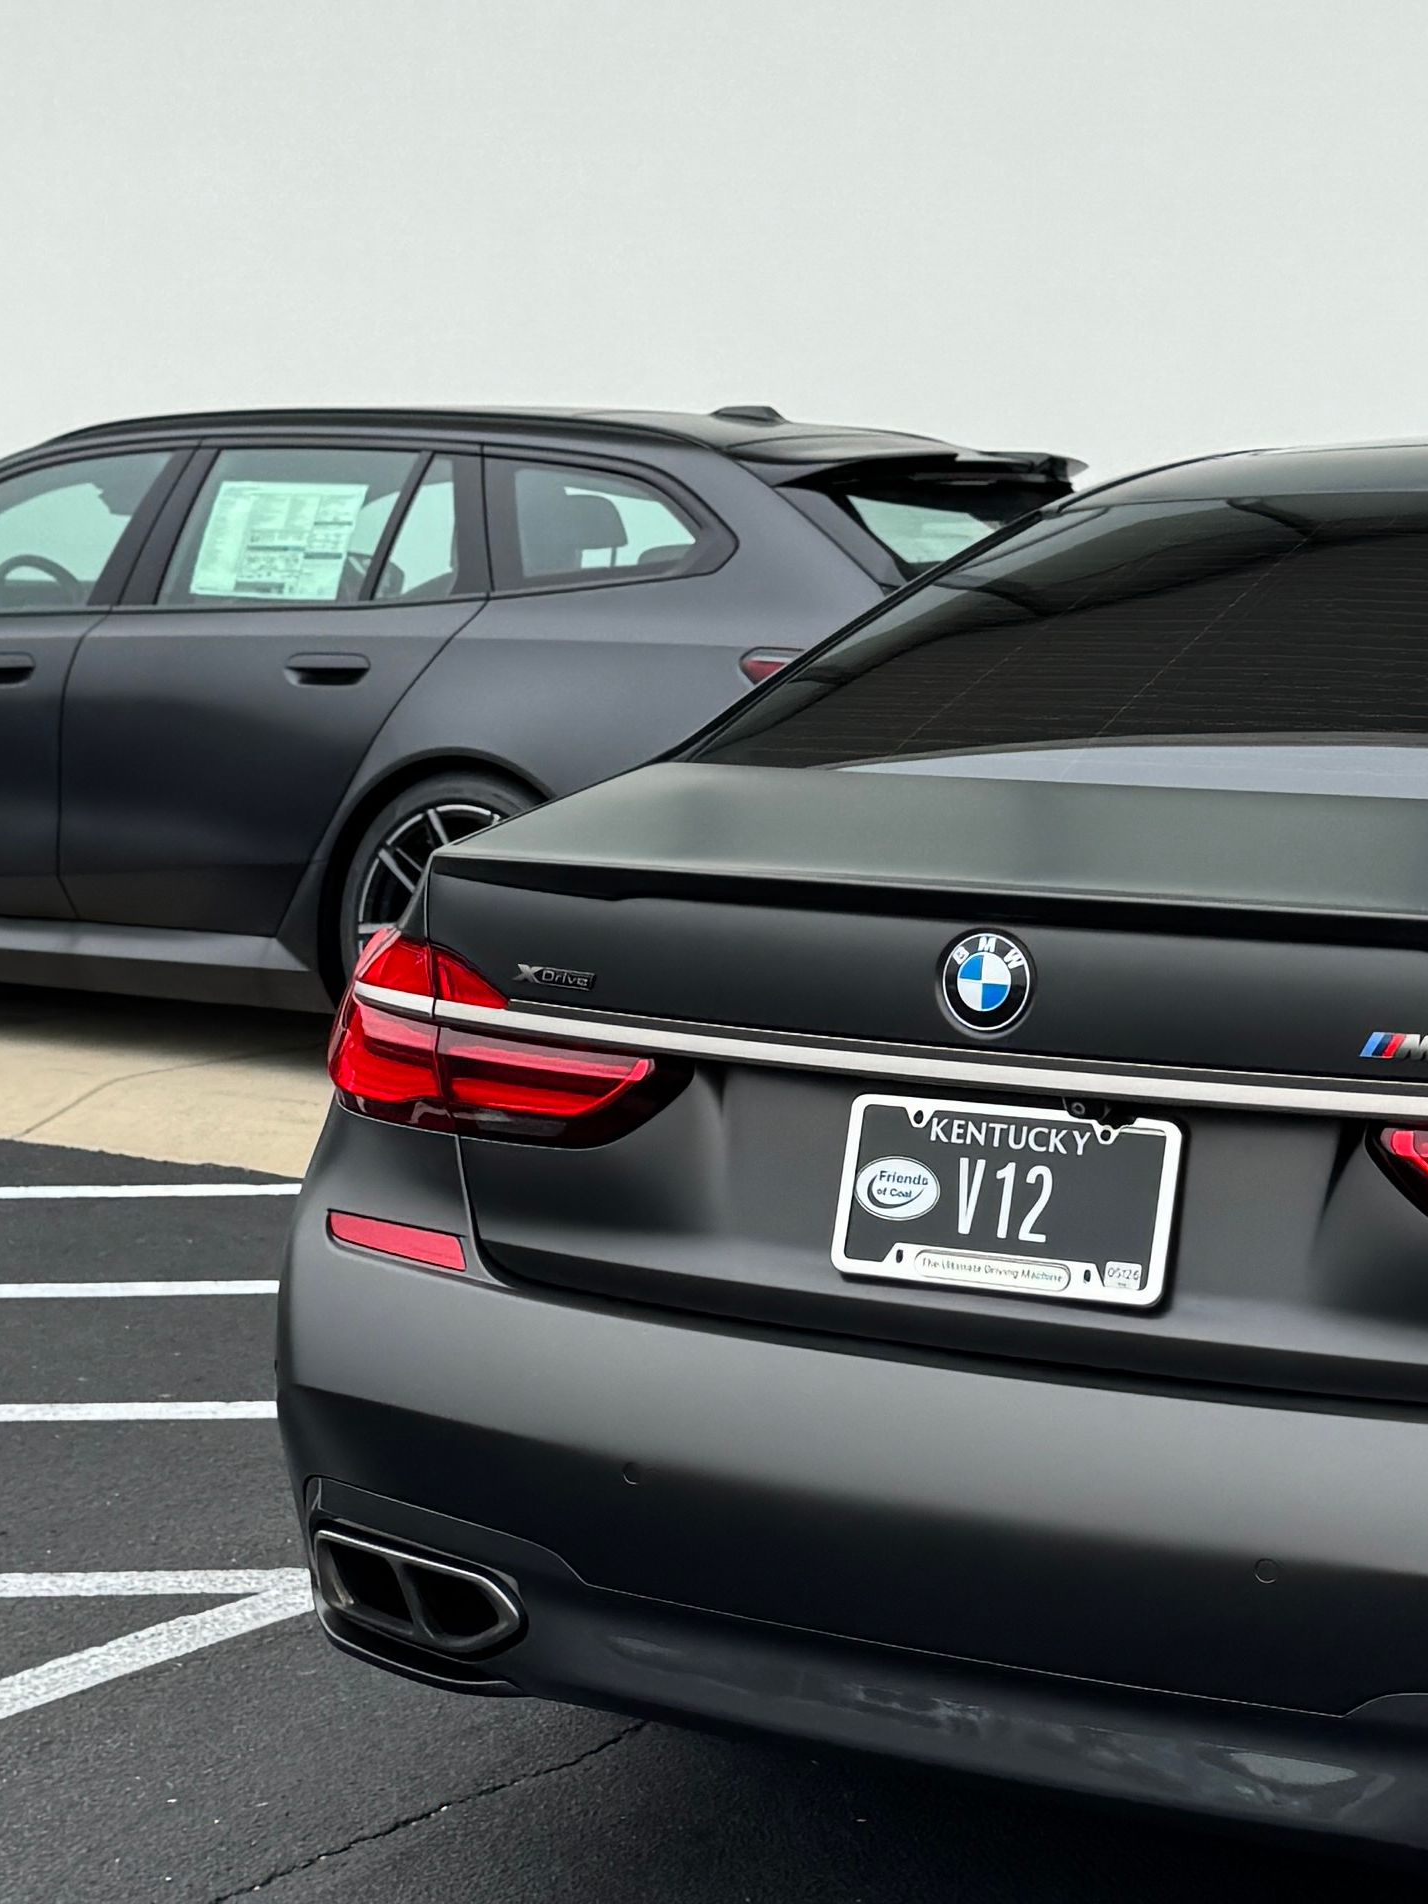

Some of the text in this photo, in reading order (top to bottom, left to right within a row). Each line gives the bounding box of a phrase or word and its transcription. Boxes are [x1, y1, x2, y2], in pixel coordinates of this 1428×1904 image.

[952, 935, 1026, 970] BMW
[929, 1117, 1092, 1156] KENTUCKY
[879, 1170, 929, 1186] Friends
[876, 1187, 912, 1198] of Coal
[957, 1157, 1054, 1243] V12
[984, 1264, 1019, 1279] Driving
[1021, 1269, 1063, 1282] Machine
